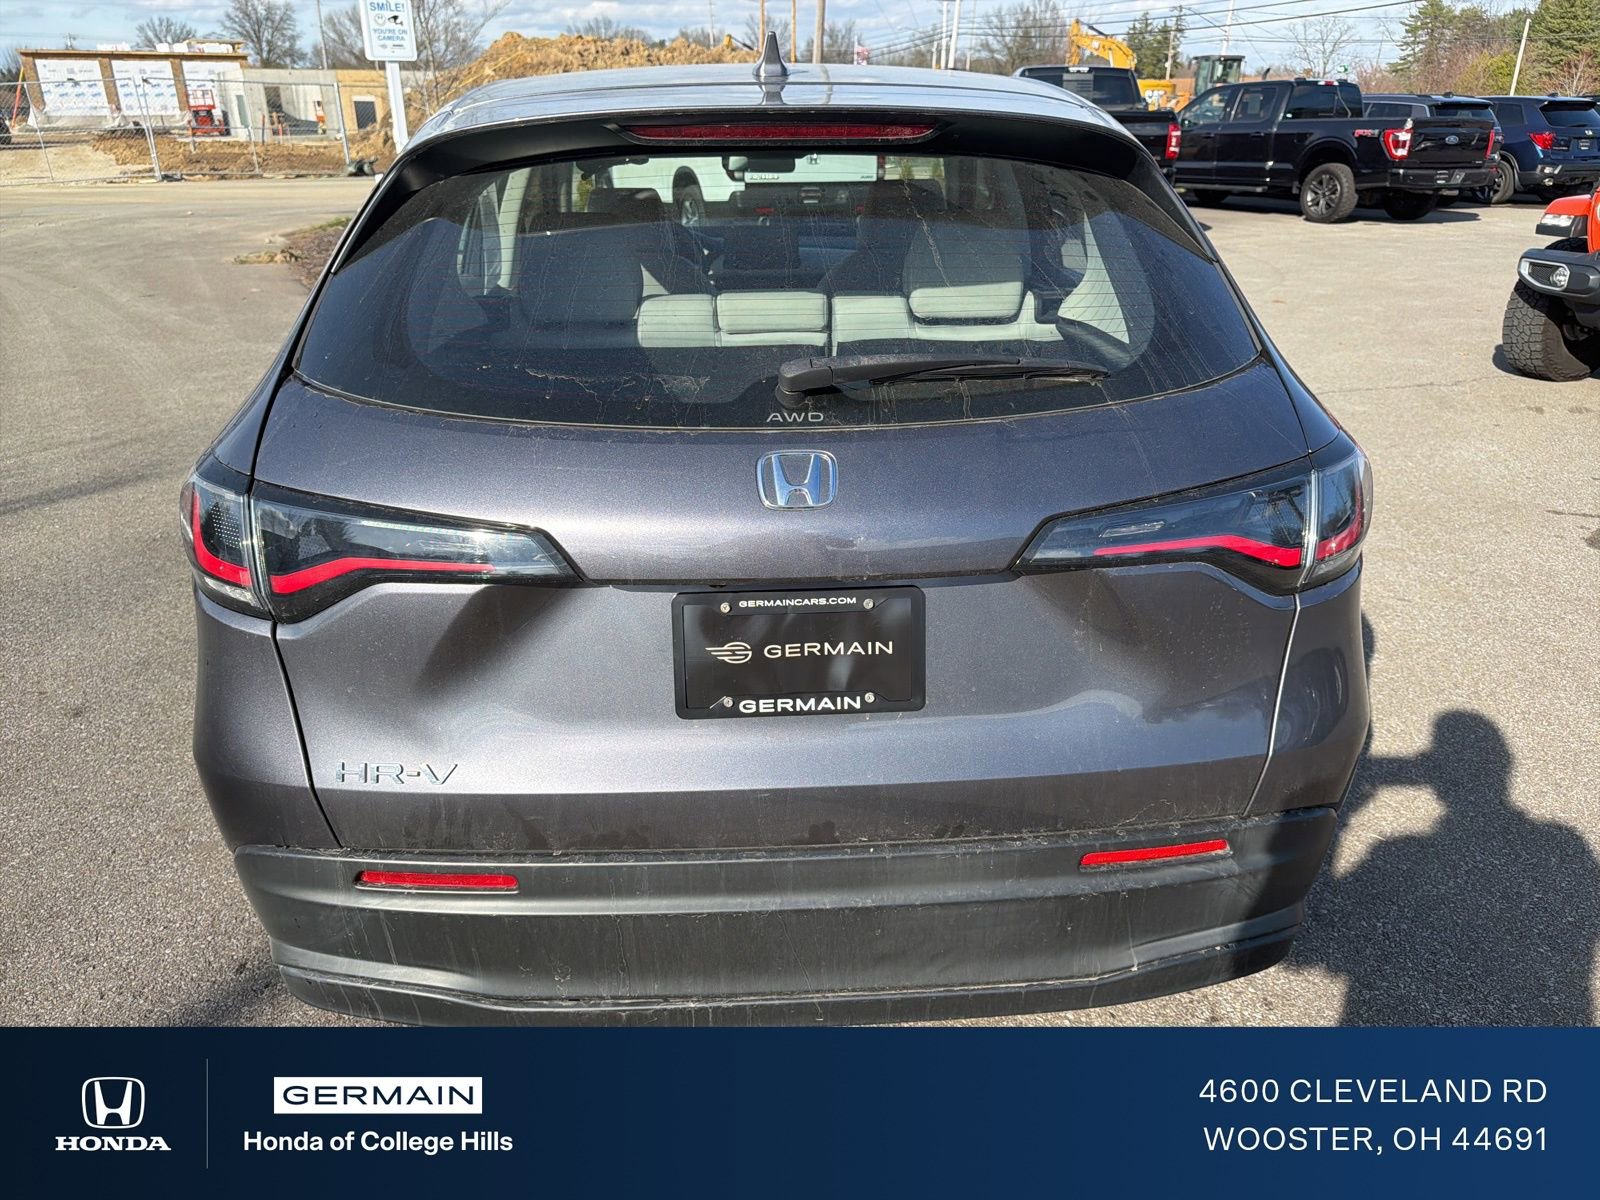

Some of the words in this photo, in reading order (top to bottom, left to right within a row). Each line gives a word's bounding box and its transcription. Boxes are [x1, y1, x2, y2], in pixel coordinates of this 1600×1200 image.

[369, 2, 405, 12] SMILE!
[766, 412, 825, 423] AWD
[738, 597, 857, 608] GERMAINCARS.COM
[763, 640, 893, 659] GERMAIN
[738, 695, 861, 714] GERMAIN
[335, 761, 459, 786] HR-V
